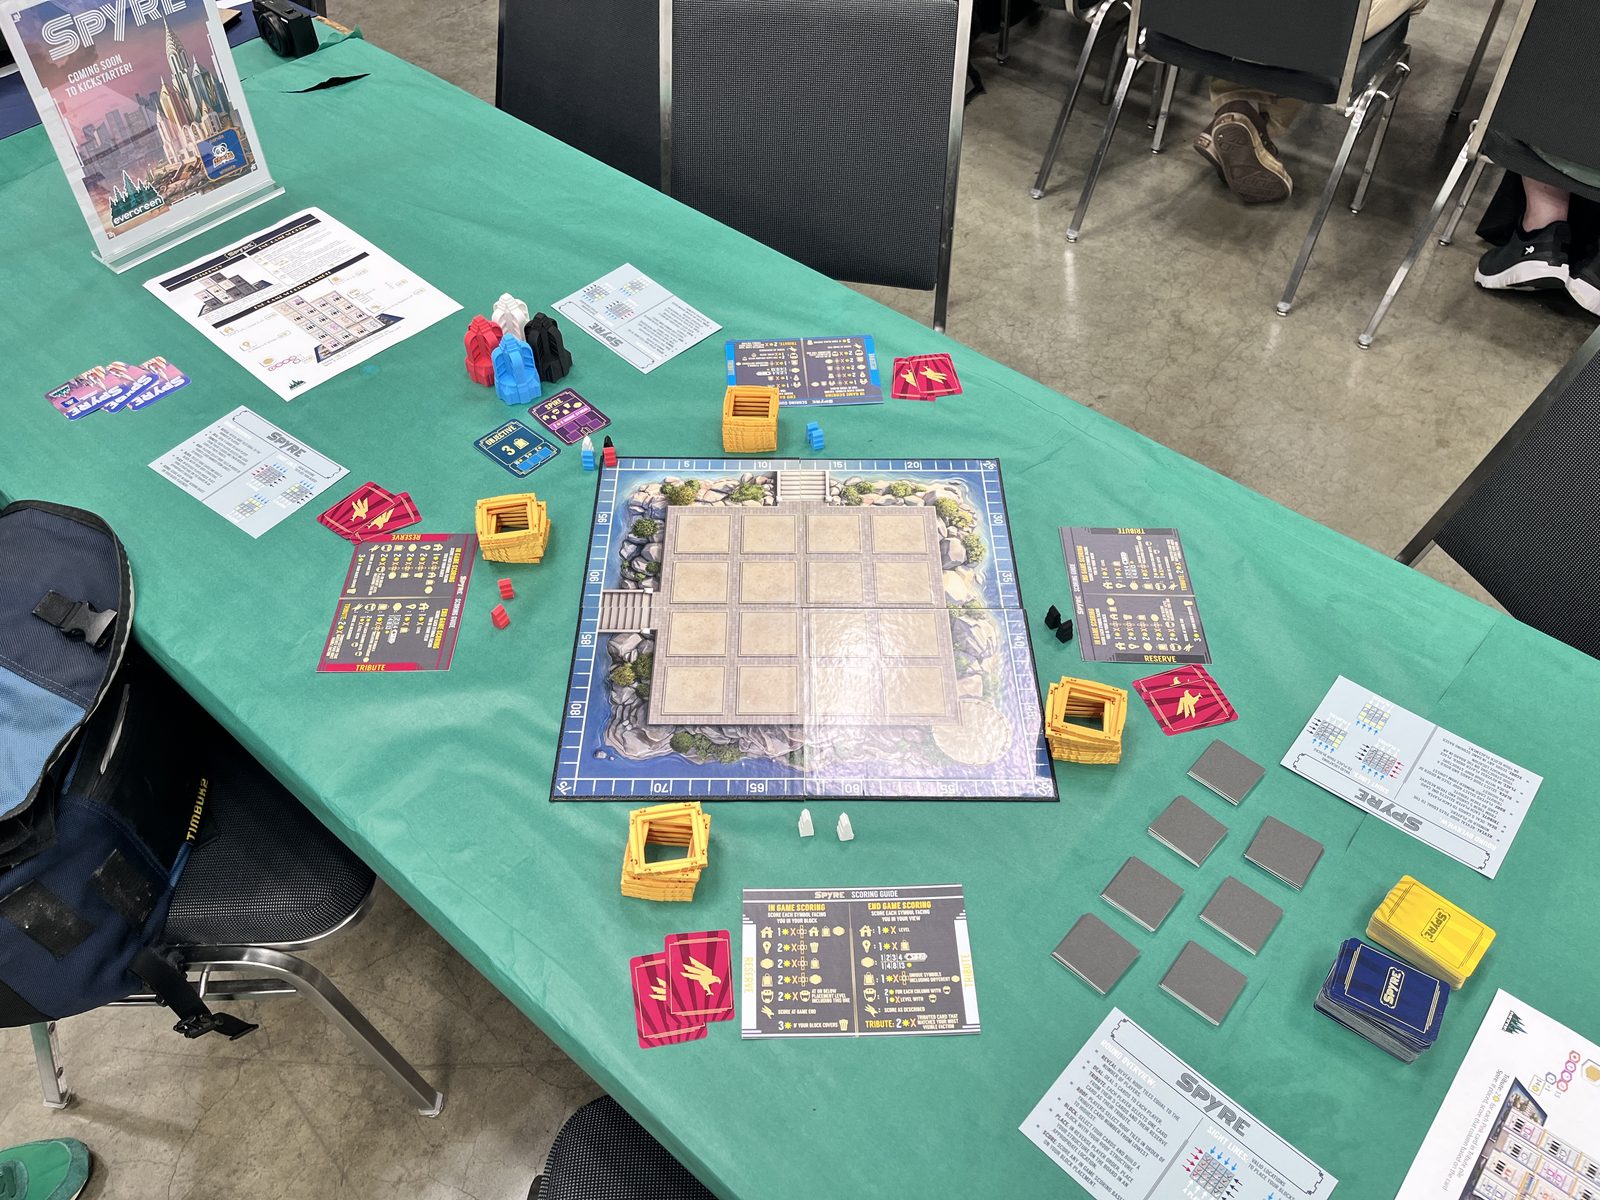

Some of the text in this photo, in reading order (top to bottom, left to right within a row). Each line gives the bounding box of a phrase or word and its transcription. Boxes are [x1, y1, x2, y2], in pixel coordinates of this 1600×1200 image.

[67, 54, 122, 84] COMING SOON
[65, 64, 134, 98] TO KICKSTARTER!
[113, 198, 162, 225] evergreen
[590, 322, 623, 347] SPYRE
[107, 375, 152, 409] SPRE
[131, 375, 185, 406] SPYRE
[68, 386, 122, 416] SPYRE
[545, 398, 563, 410] SPIRE
[267, 432, 307, 457] SPYRE
[486, 425, 517, 446] OBJECTIVE
[502, 445, 516, 456] 3
[983, 461, 997, 470] 25
[598, 513, 608, 523] 95
[993, 514, 1003, 524] 30
[590, 572, 599, 582] 90
[1002, 572, 1012, 583] 35
[448, 575, 467, 628] SPYRE SCORING GUIDE
[1074, 595, 1084, 614] SPYRE
[581, 634, 591, 644] 85
[1014, 635, 1025, 647] 40
[570, 704, 581, 715] 80
[557, 781, 572, 795] 75
[654, 783, 668, 793] 70
[750, 783, 764, 793] 65
[186, 778, 208, 840] TIMBUK2
[1352, 785, 1424, 833] SPYRE
[814, 891, 845, 899] SPYRE
[776, 903, 795, 911] GAME
[796, 903, 825, 911] SCORING
[867, 902, 881, 910] END
[902, 901, 931, 909] SCORING
[1425, 912, 1447, 940] SPYRE
[744, 956, 753, 992] RESERVE
[960, 952, 973, 986] TRIBUTE
[1383, 970, 1402, 1005] SPYRE
[865, 1019, 894, 1028] TRIBUTE:
[1176, 1072, 1251, 1137] SPYRE
[1206, 1125, 1228, 1145] SIGHT
